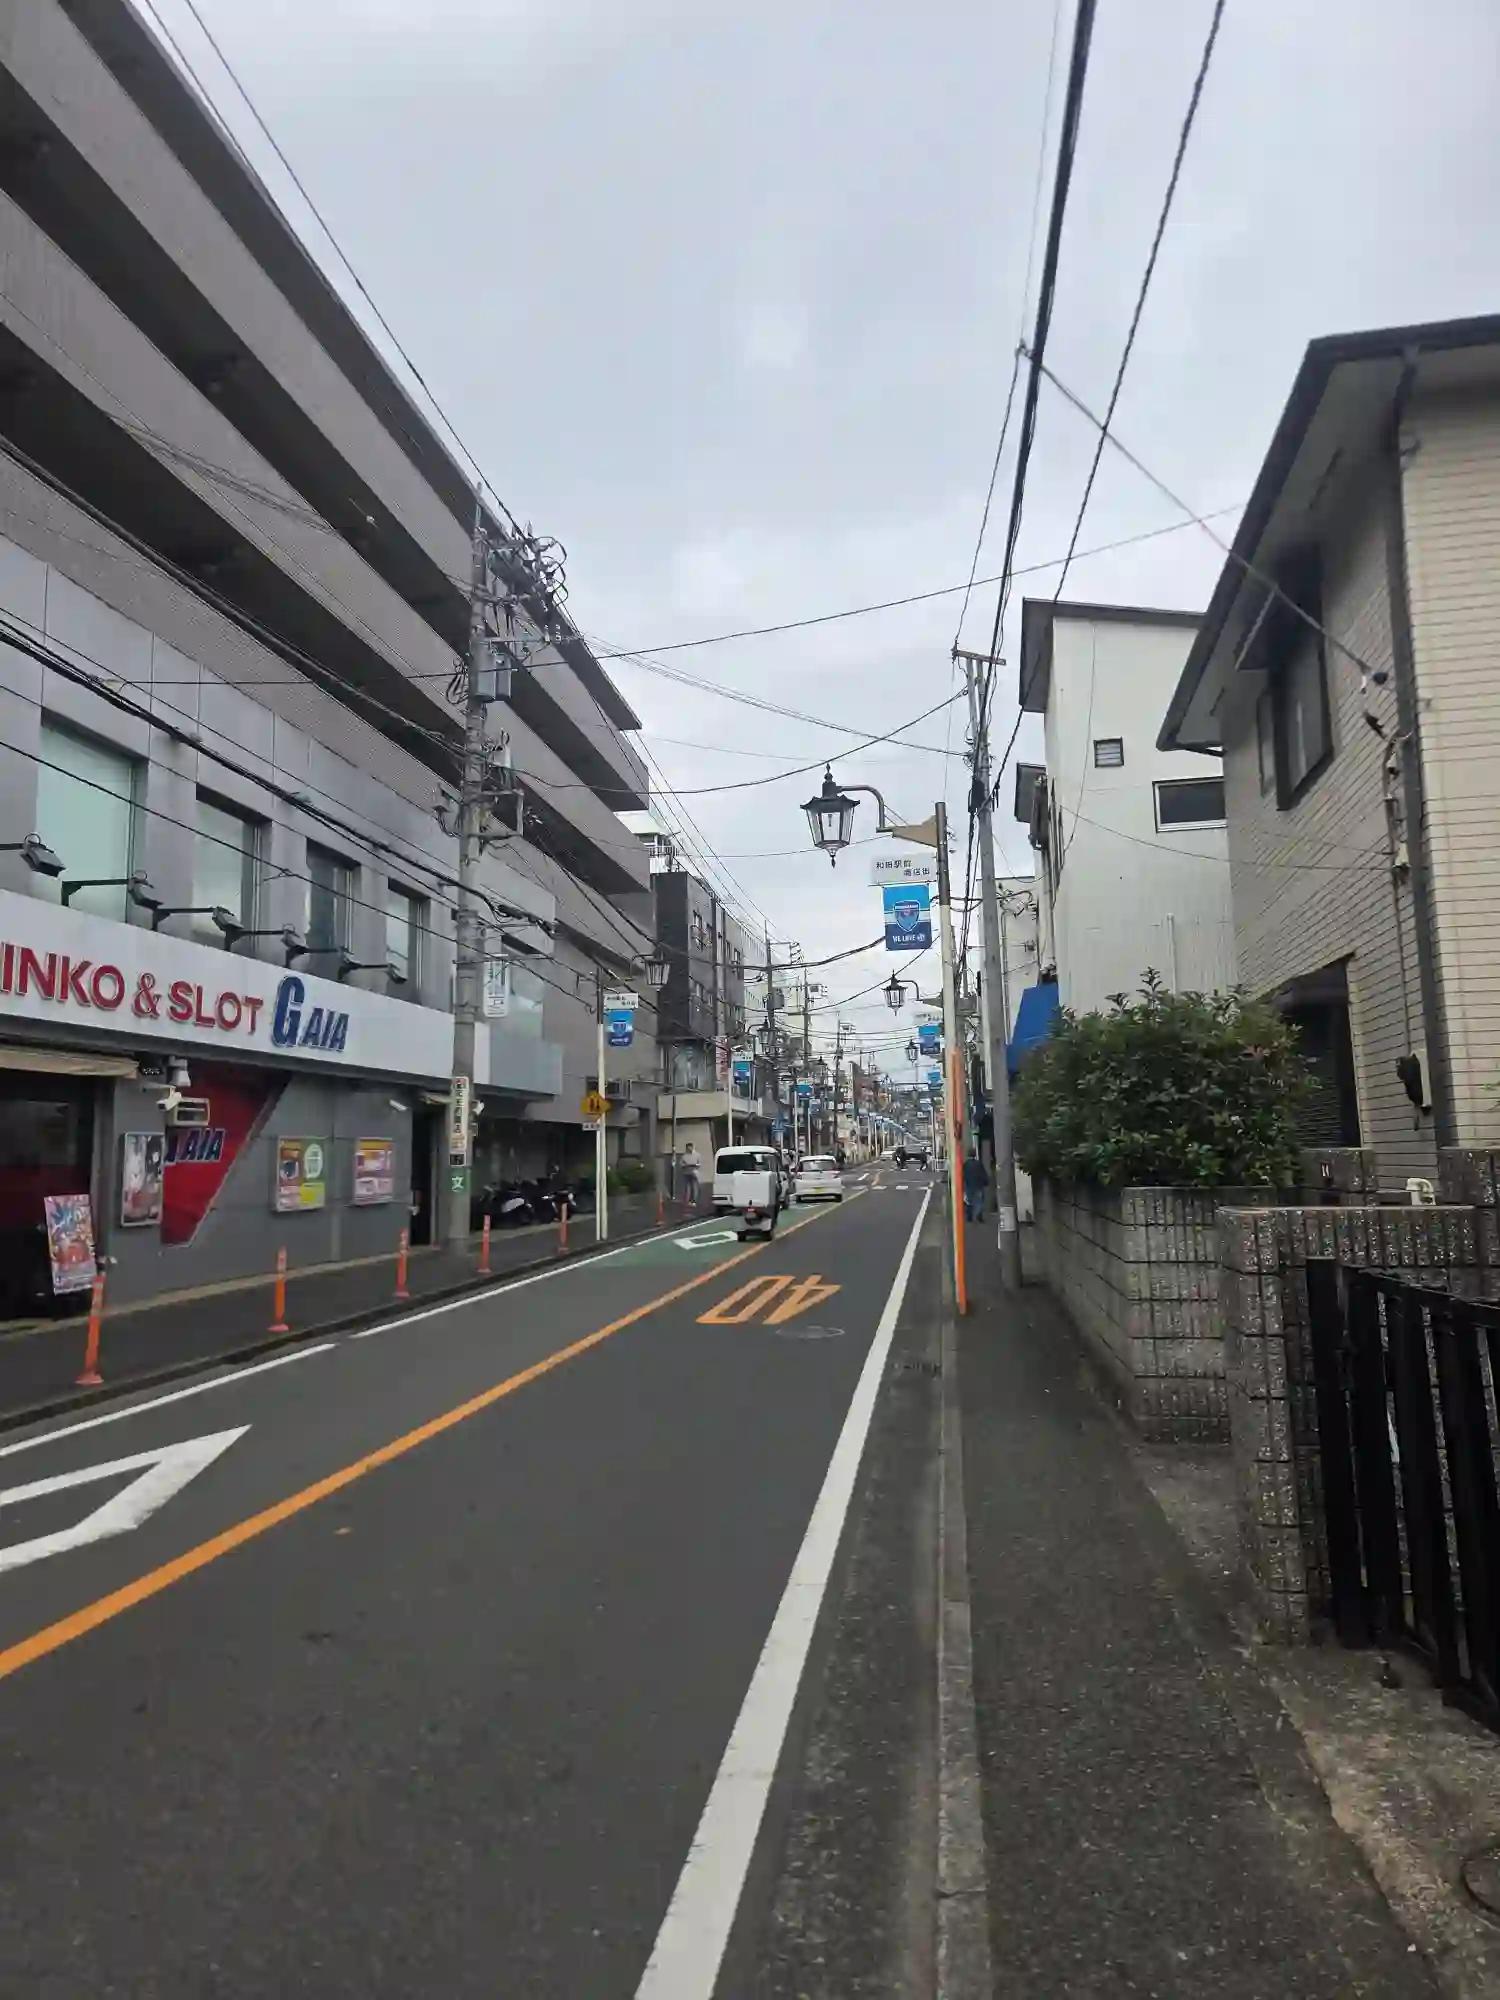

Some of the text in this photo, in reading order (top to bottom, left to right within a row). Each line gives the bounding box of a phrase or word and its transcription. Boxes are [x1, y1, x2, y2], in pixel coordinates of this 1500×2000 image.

[132, 972, 161, 1019] &
[168, 980, 263, 1034] SLOT
[451, 1176, 464, 1192] 文
[695, 1275, 842, 1325] 40
